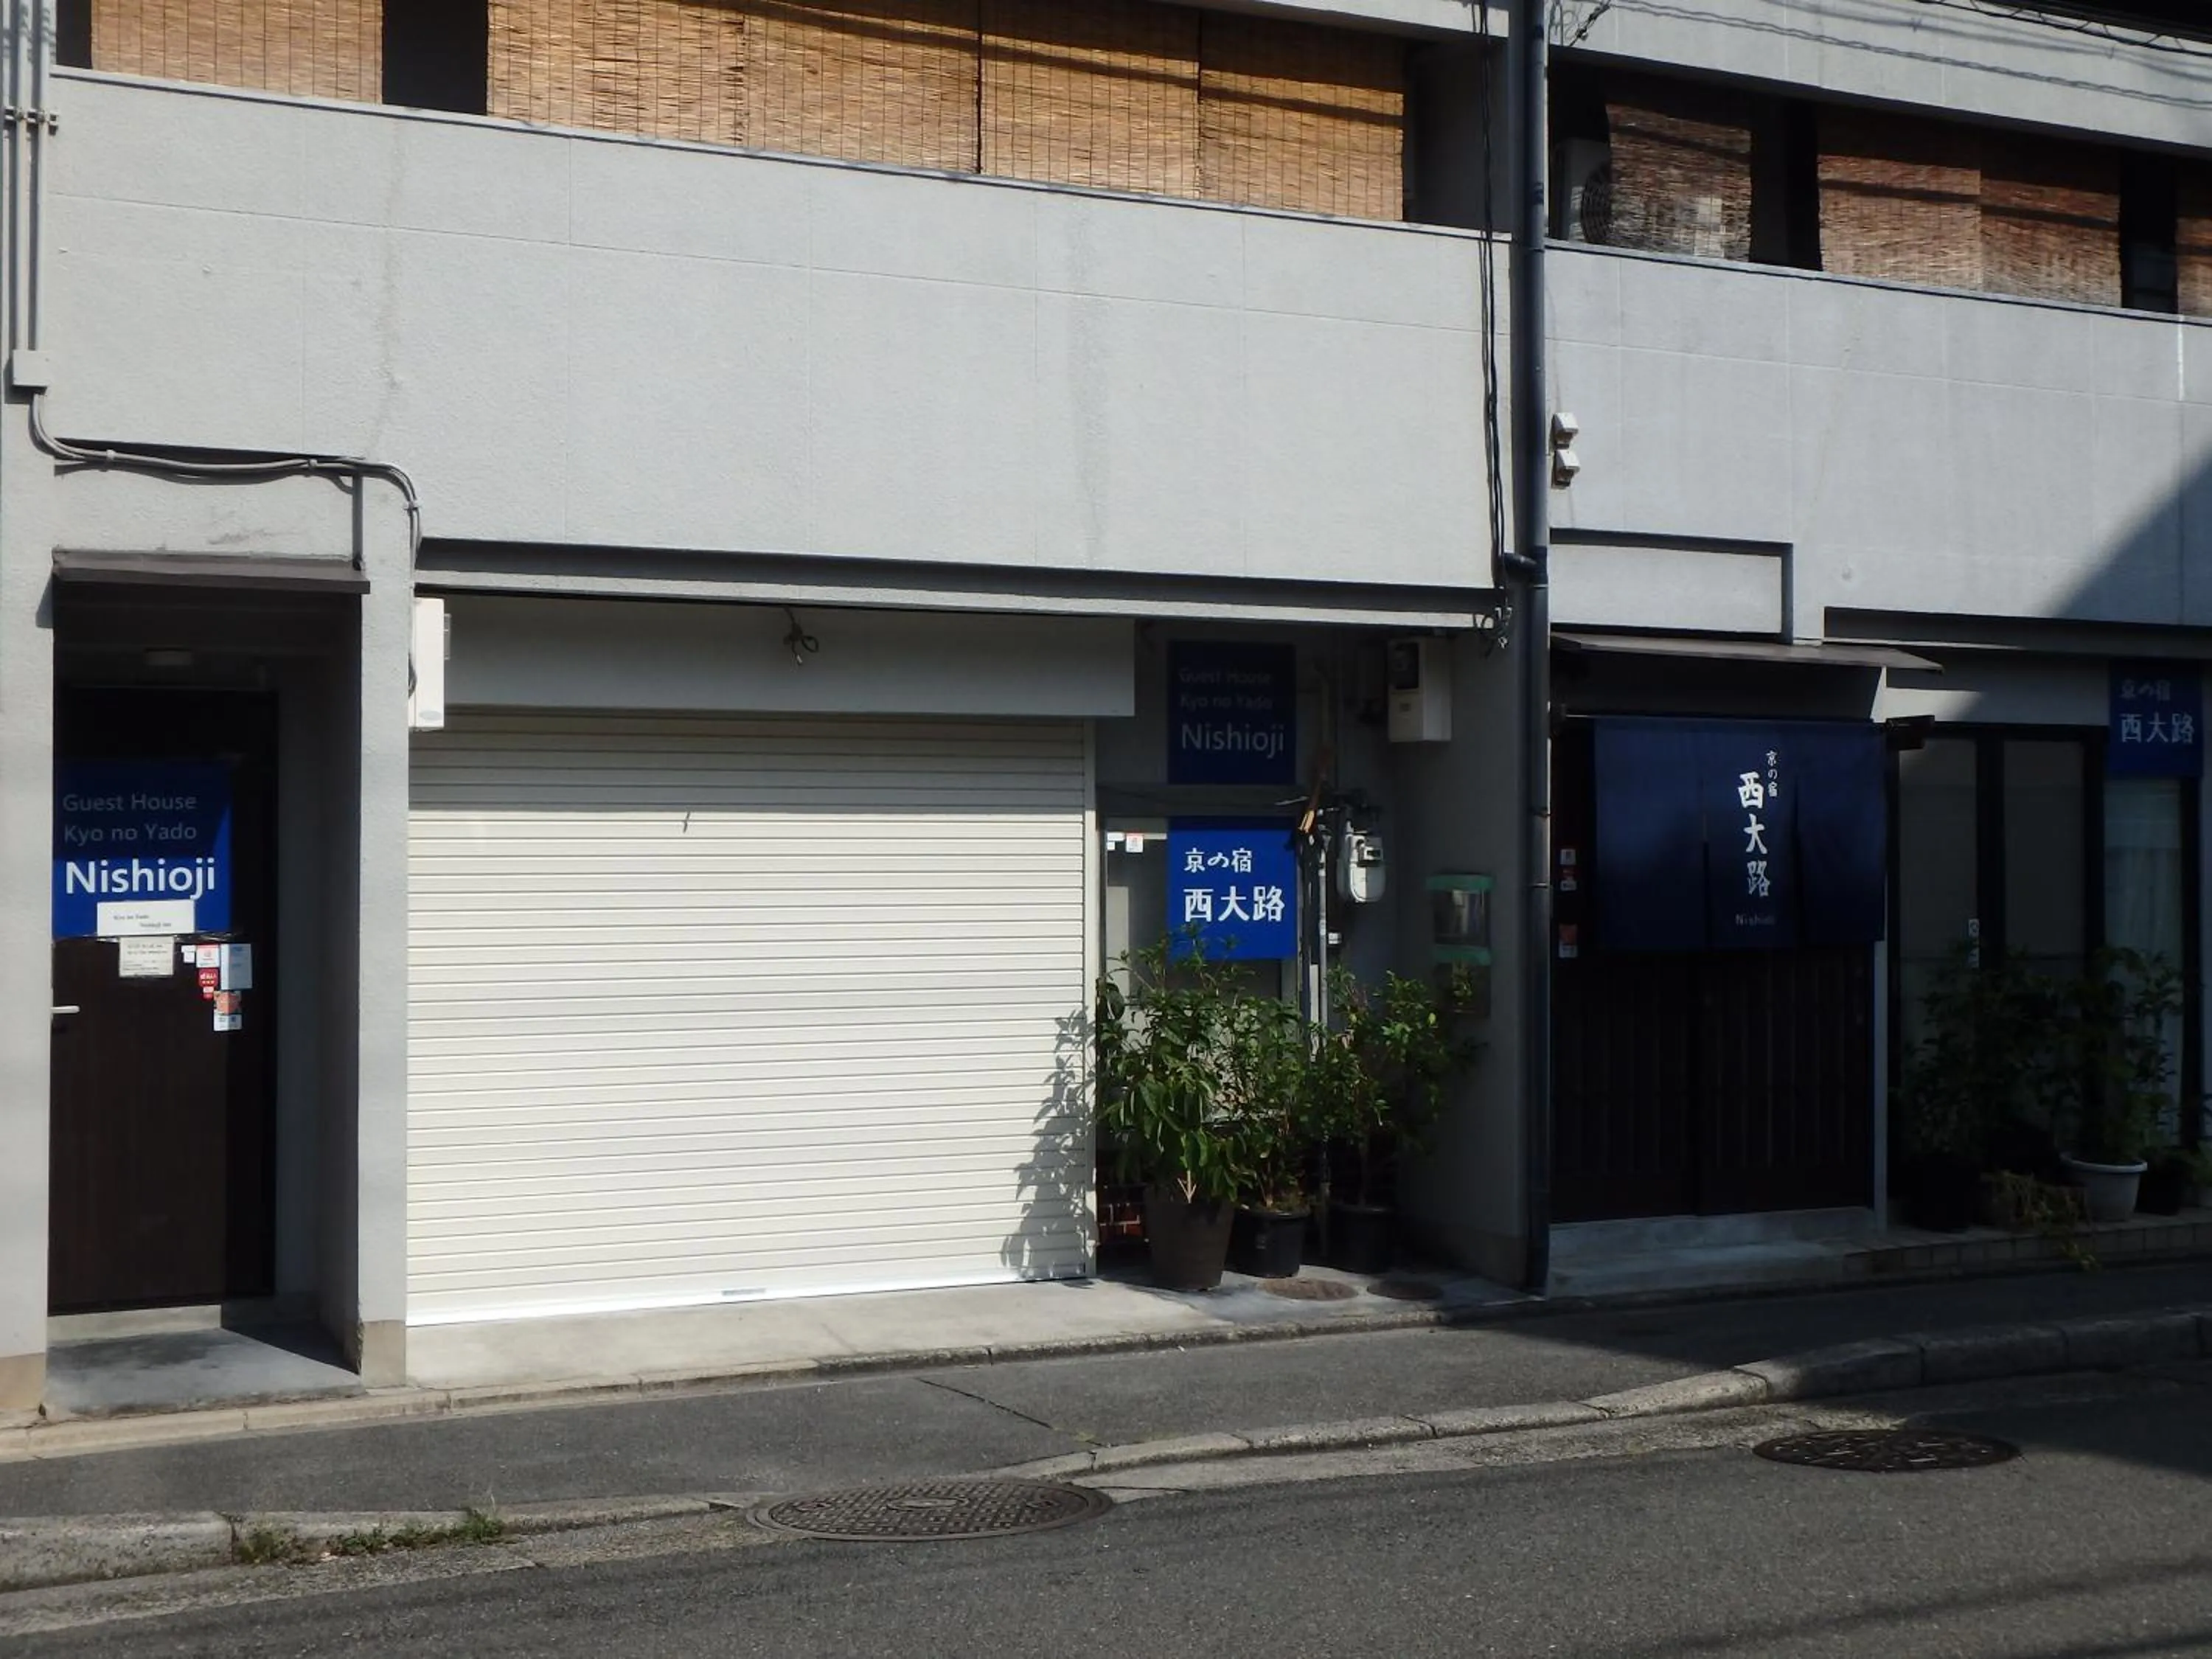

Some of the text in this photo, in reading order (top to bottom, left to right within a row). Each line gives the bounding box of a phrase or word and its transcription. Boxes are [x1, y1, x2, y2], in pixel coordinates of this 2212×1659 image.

[1213, 697, 1232, 708] no
[2120, 678, 2171, 700] 京の宿
[1181, 722, 1284, 759] Nishioji
[2119, 711, 2194, 744] 西大路
[1766, 749, 1778, 798] 京の宿
[62, 792, 198, 812] Guest House
[64, 823, 197, 847] Kyo no Yado
[1737, 771, 1770, 897] 西大路
[1183, 847, 1253, 874] 京の宿
[66, 857, 215, 900] Nishioji
[1183, 885, 1286, 922] 西大路
